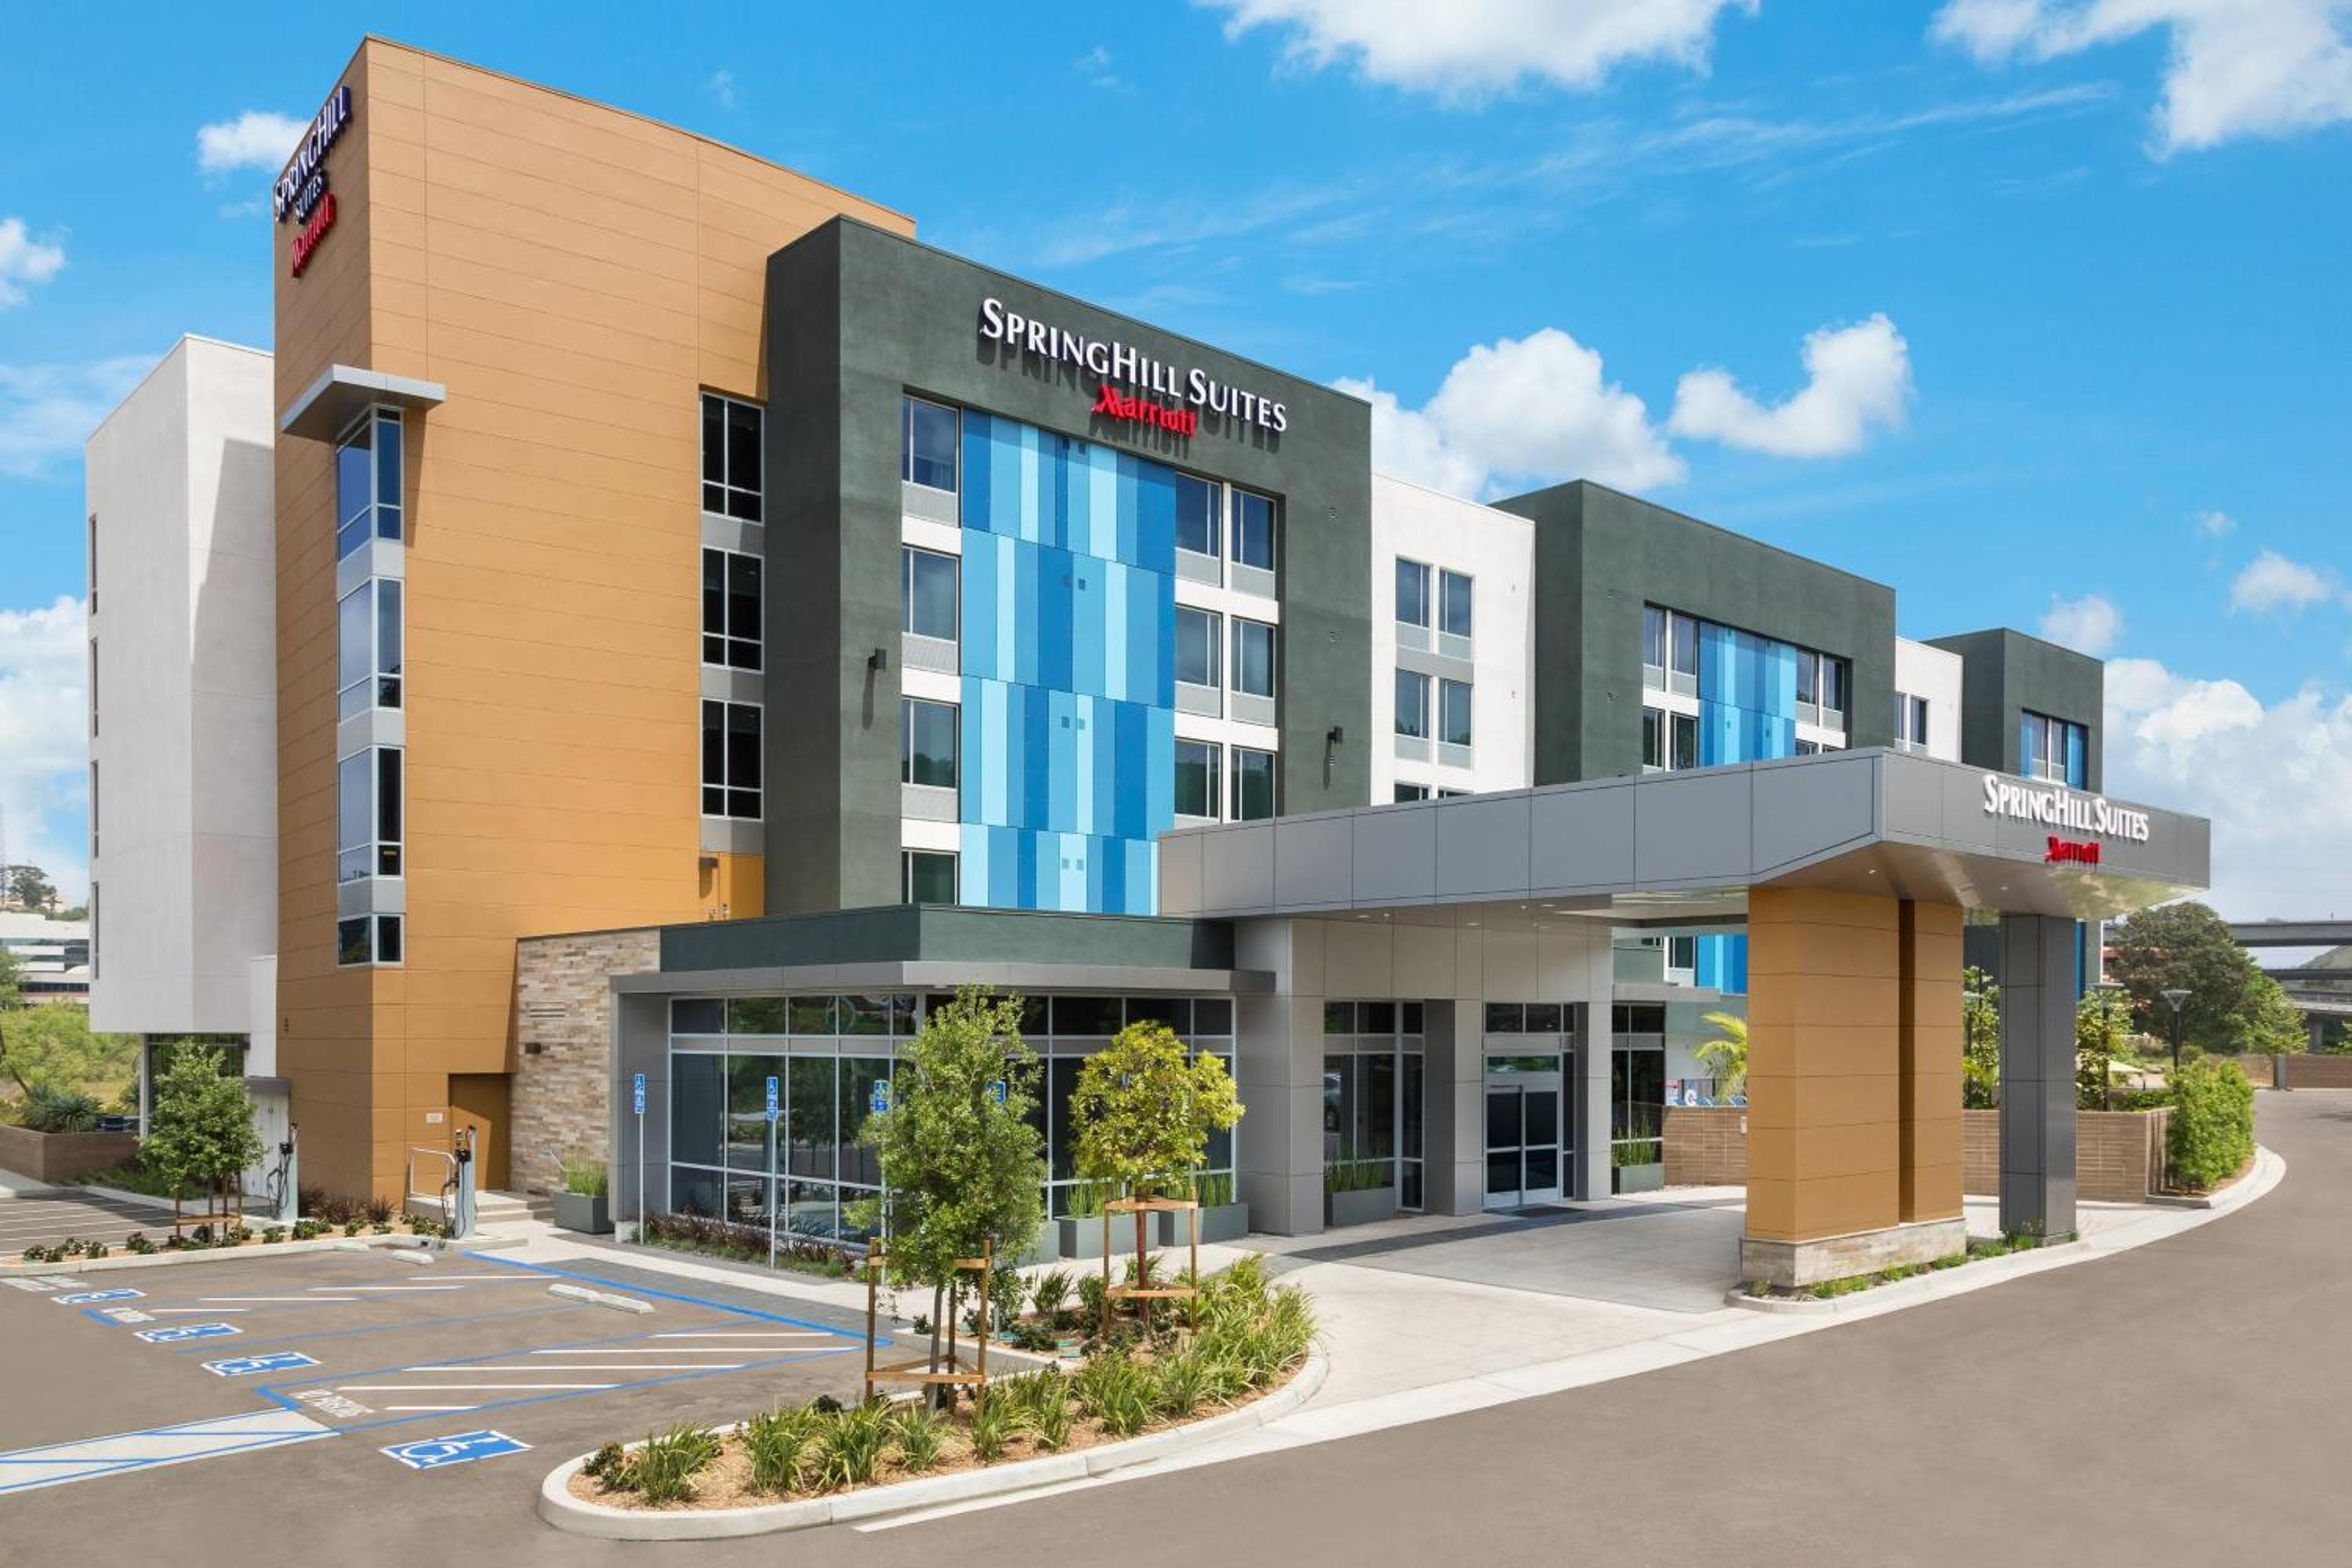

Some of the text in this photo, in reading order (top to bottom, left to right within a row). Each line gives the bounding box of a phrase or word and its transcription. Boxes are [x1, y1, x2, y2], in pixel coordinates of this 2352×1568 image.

[980, 297, 1287, 433] SPRINGHILL SUITES
[1091, 384, 1196, 437] Marriott
[1984, 774, 2149, 841] SPRINGHILL SUITES
